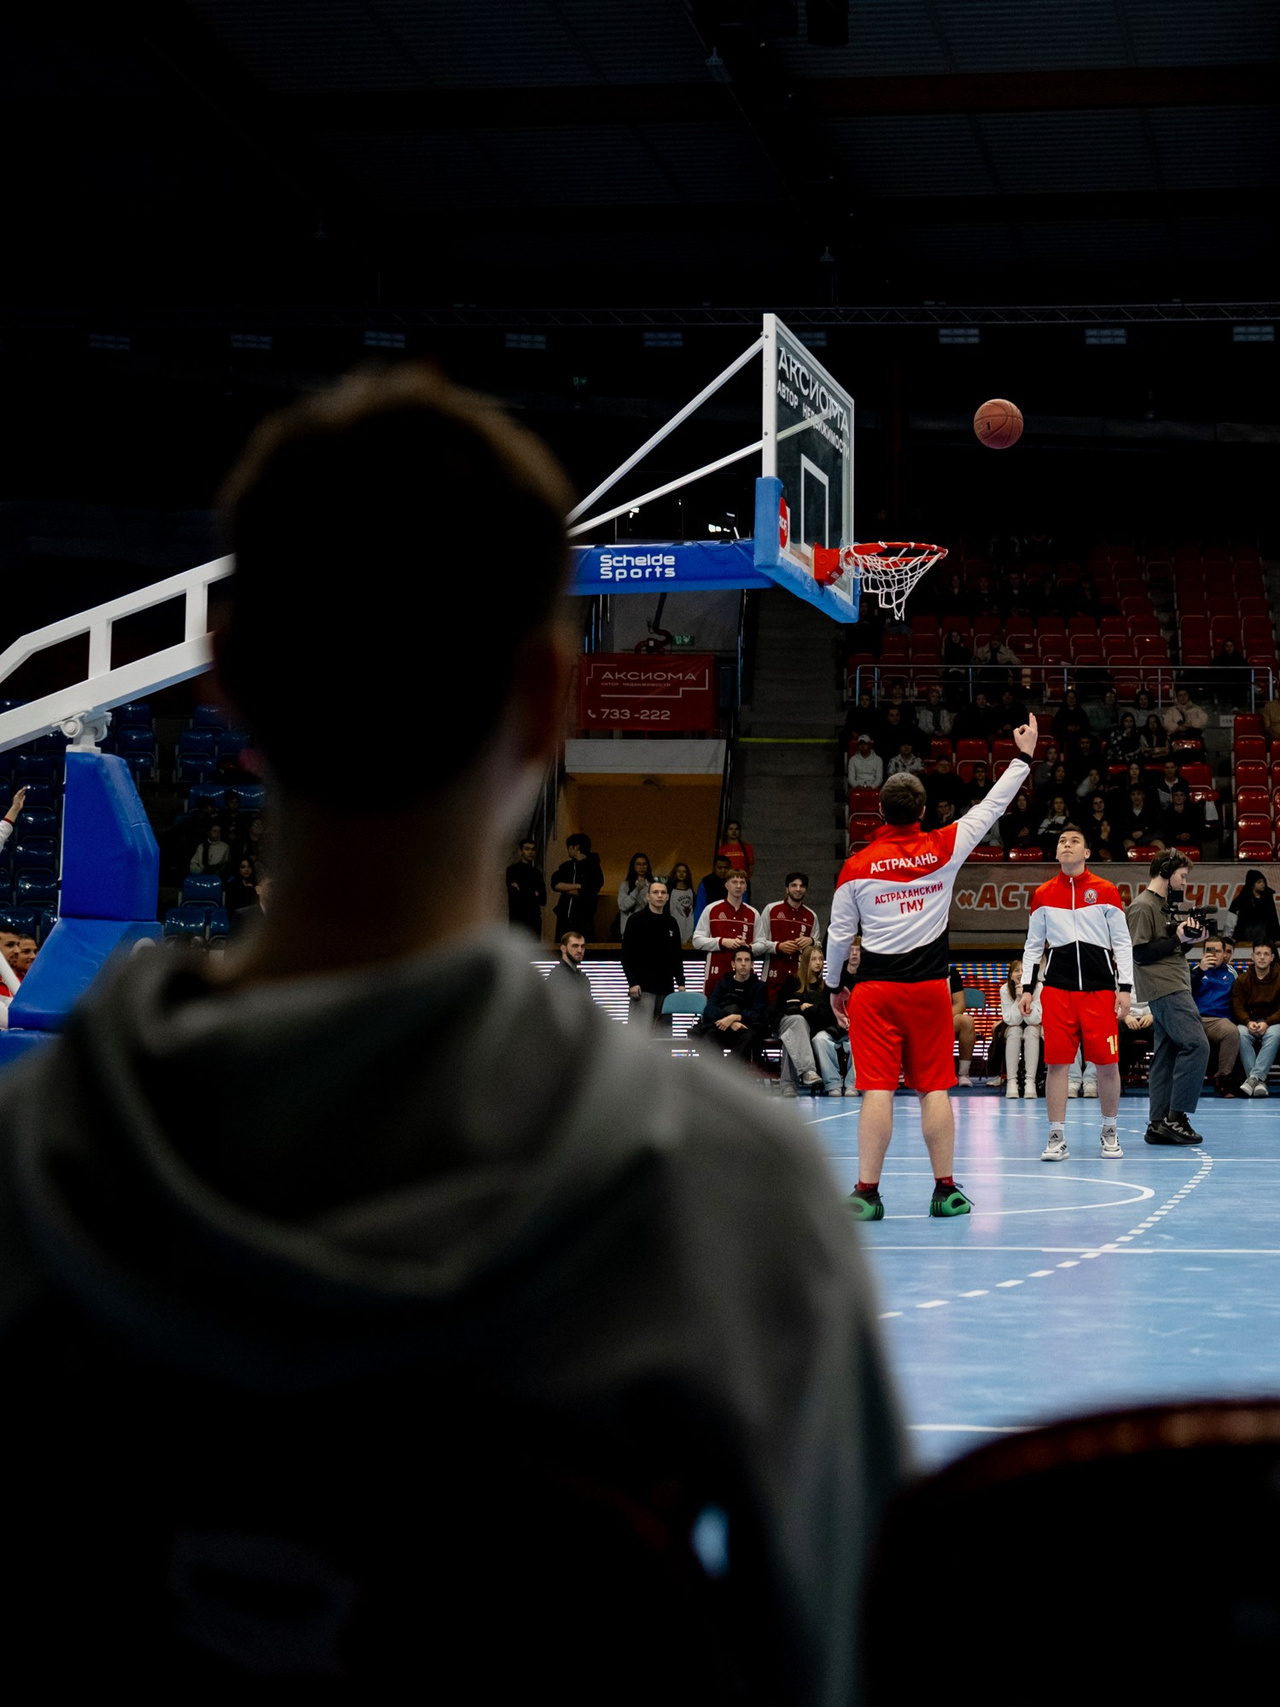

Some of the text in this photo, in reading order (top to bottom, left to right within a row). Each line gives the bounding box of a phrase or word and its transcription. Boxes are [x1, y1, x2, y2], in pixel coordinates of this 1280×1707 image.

[778, 347, 850, 438] АКСИОМА
[600, 553, 676, 567] Schelde
[600, 566, 676, 582] Sports
[601, 671, 697, 681] АКСИОМА
[600, 708, 630, 720] 733
[870, 852, 939, 875] АСТРАХАНЬ
[874, 881, 944, 905] АСТРАХАНСКИЙ
[900, 898, 924, 914] ГМУ
